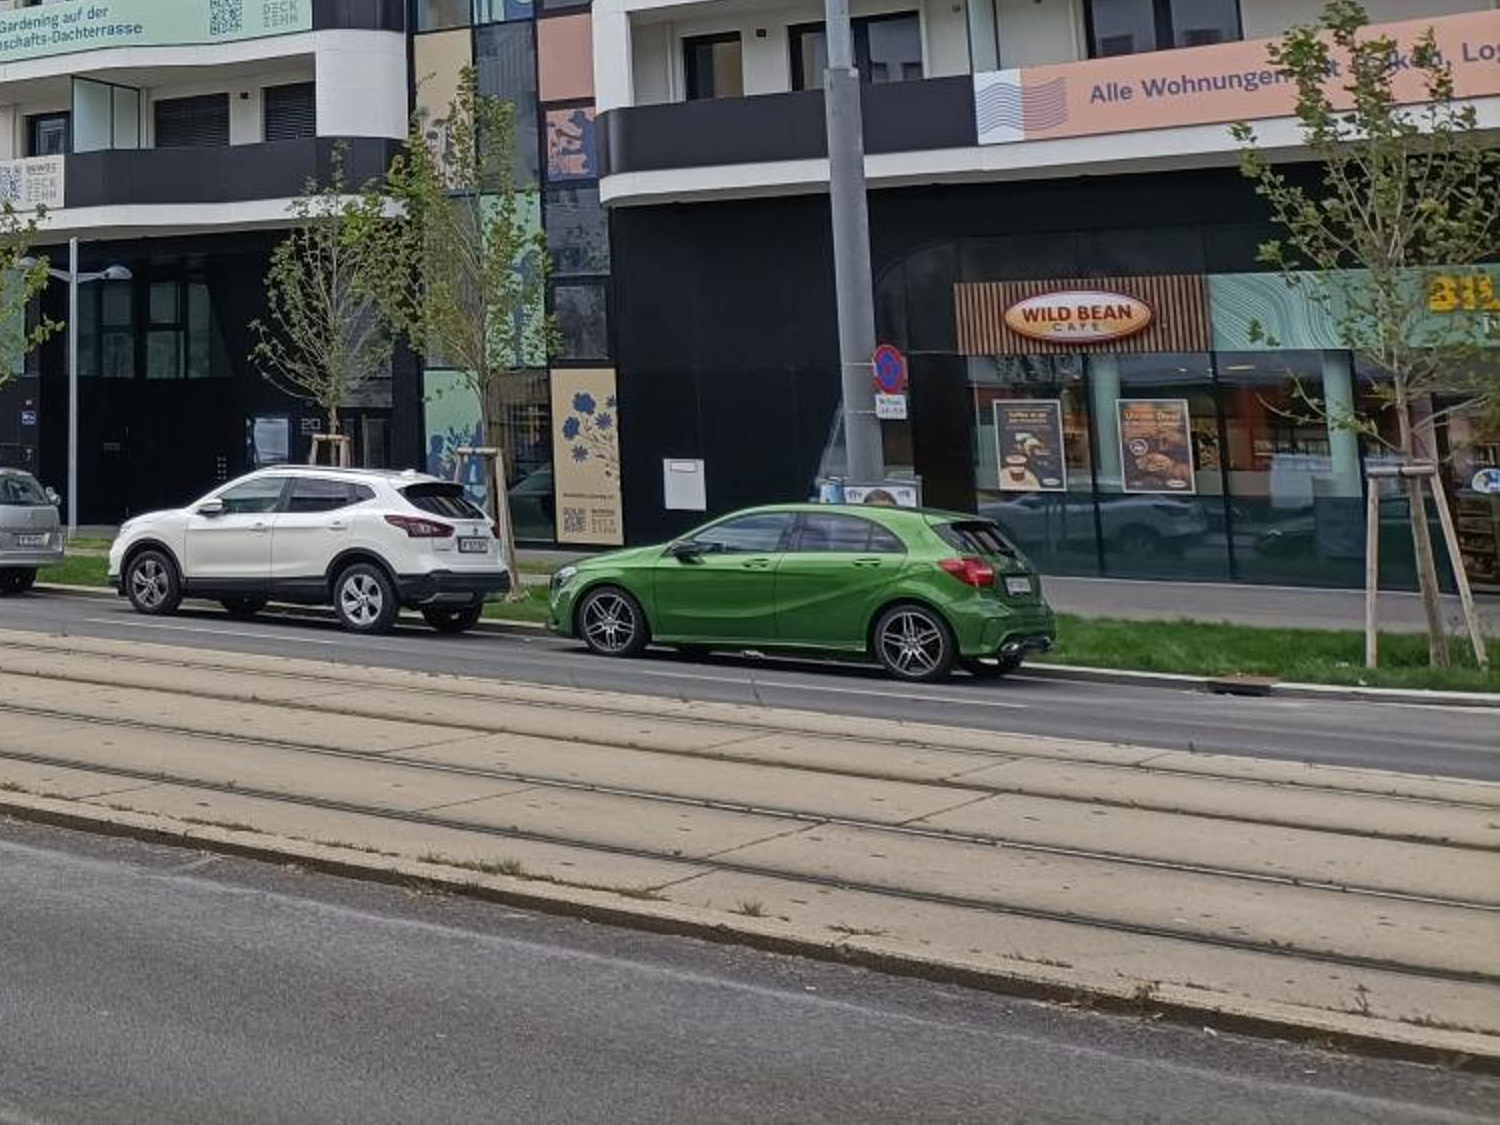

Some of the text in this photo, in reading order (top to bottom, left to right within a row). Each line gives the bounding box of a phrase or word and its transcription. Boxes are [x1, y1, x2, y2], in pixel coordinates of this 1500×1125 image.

[63, 6, 83, 23] auf
[87, 6, 110, 21] der
[1090, 84, 1134, 104] Alle
[1141, 67, 1291, 99] Wohnungen
[1022, 304, 1132, 323] WILD BEAN
